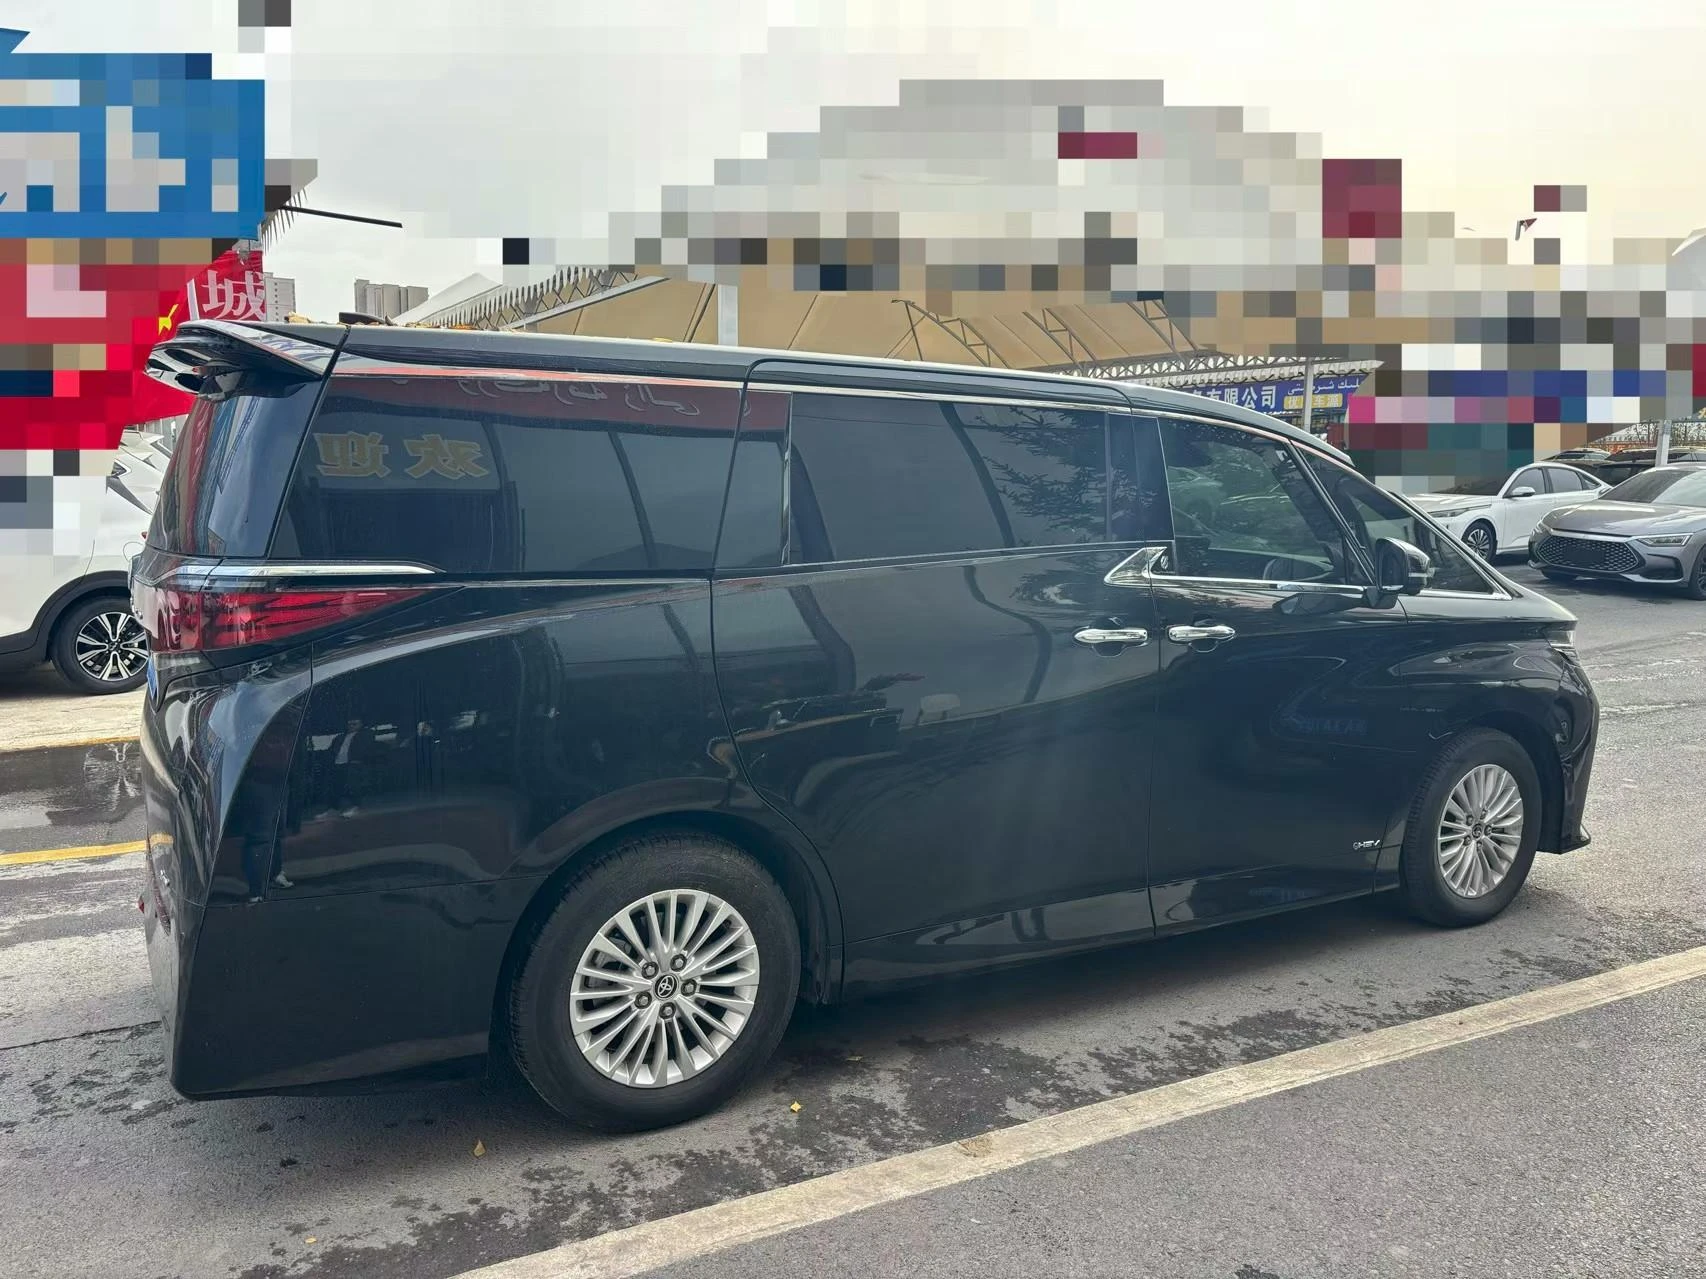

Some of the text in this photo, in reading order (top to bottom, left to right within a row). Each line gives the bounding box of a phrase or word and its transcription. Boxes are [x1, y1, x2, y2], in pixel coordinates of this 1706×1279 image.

[187, 270, 266, 321] 城
[1192, 385, 1276, 409] 有限公司
